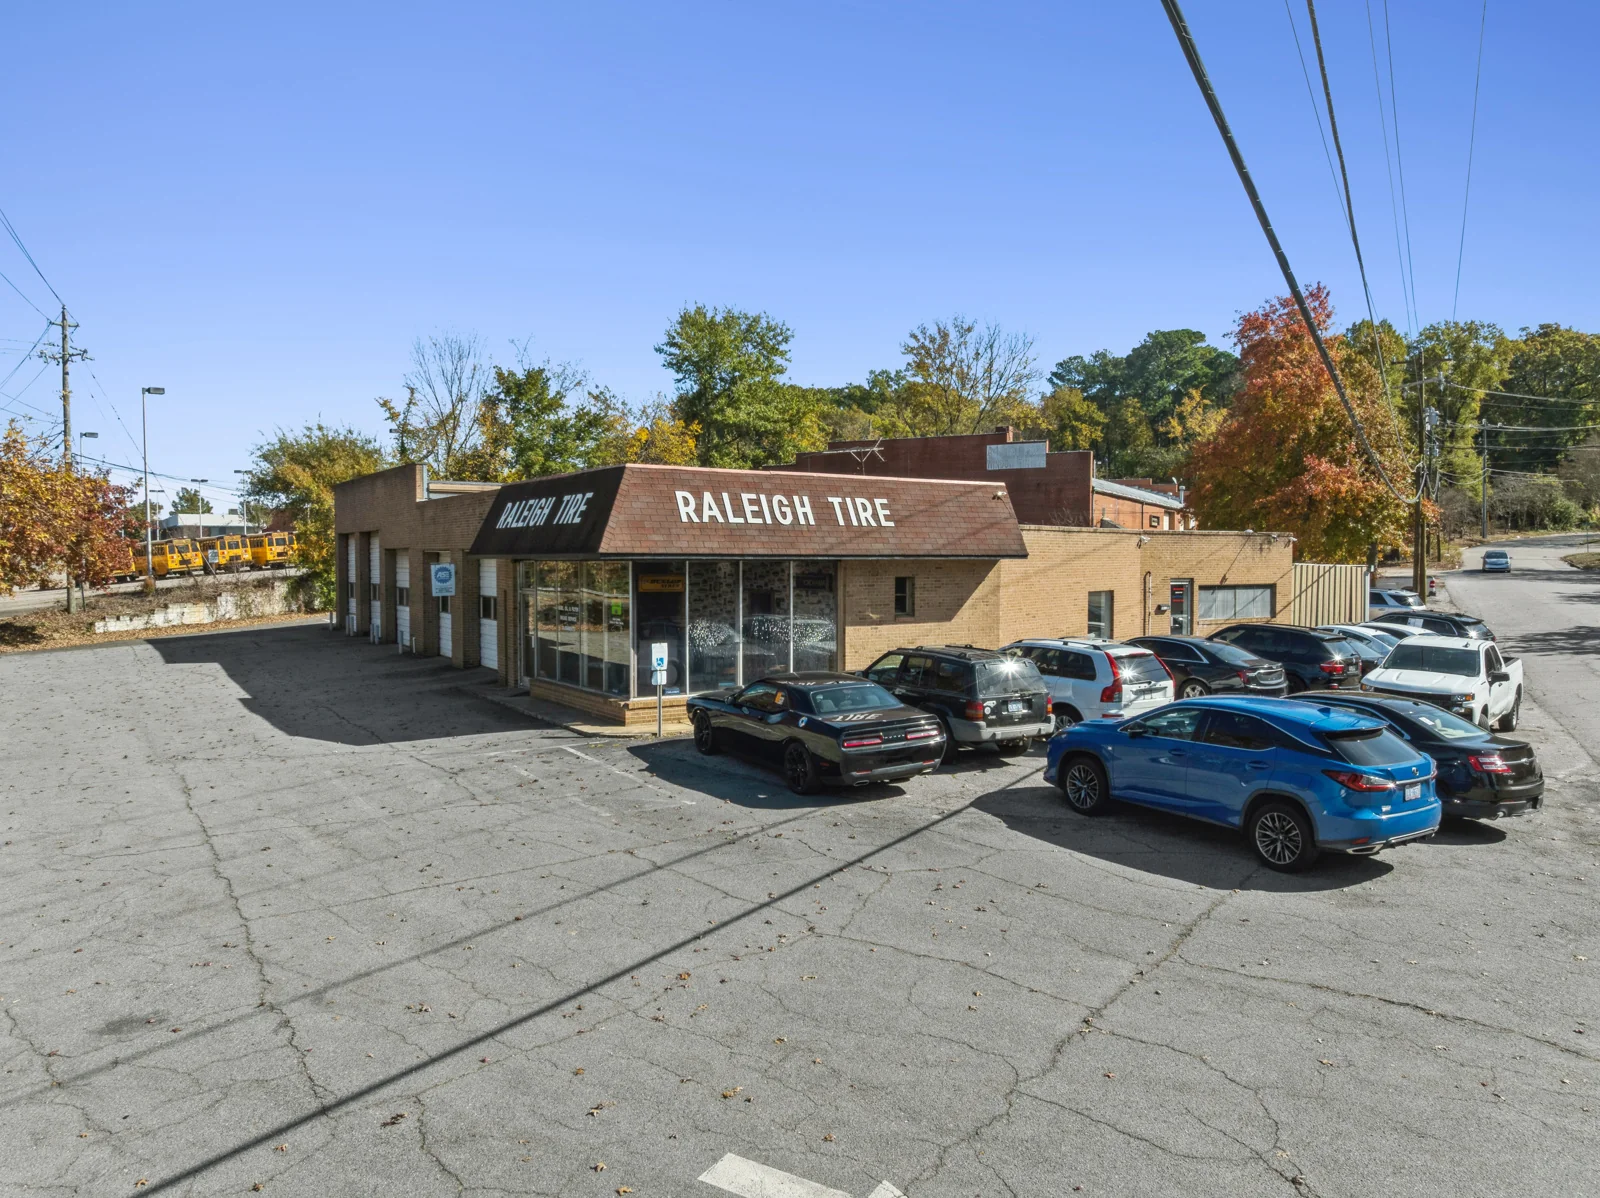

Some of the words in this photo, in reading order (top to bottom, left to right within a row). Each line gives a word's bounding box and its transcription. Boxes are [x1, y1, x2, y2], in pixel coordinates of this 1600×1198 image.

[496, 497, 556, 529] RALEIGH
[553, 492, 594, 525] TIRE
[675, 491, 815, 526] RALEIGH
[828, 497, 895, 527] TIRE
